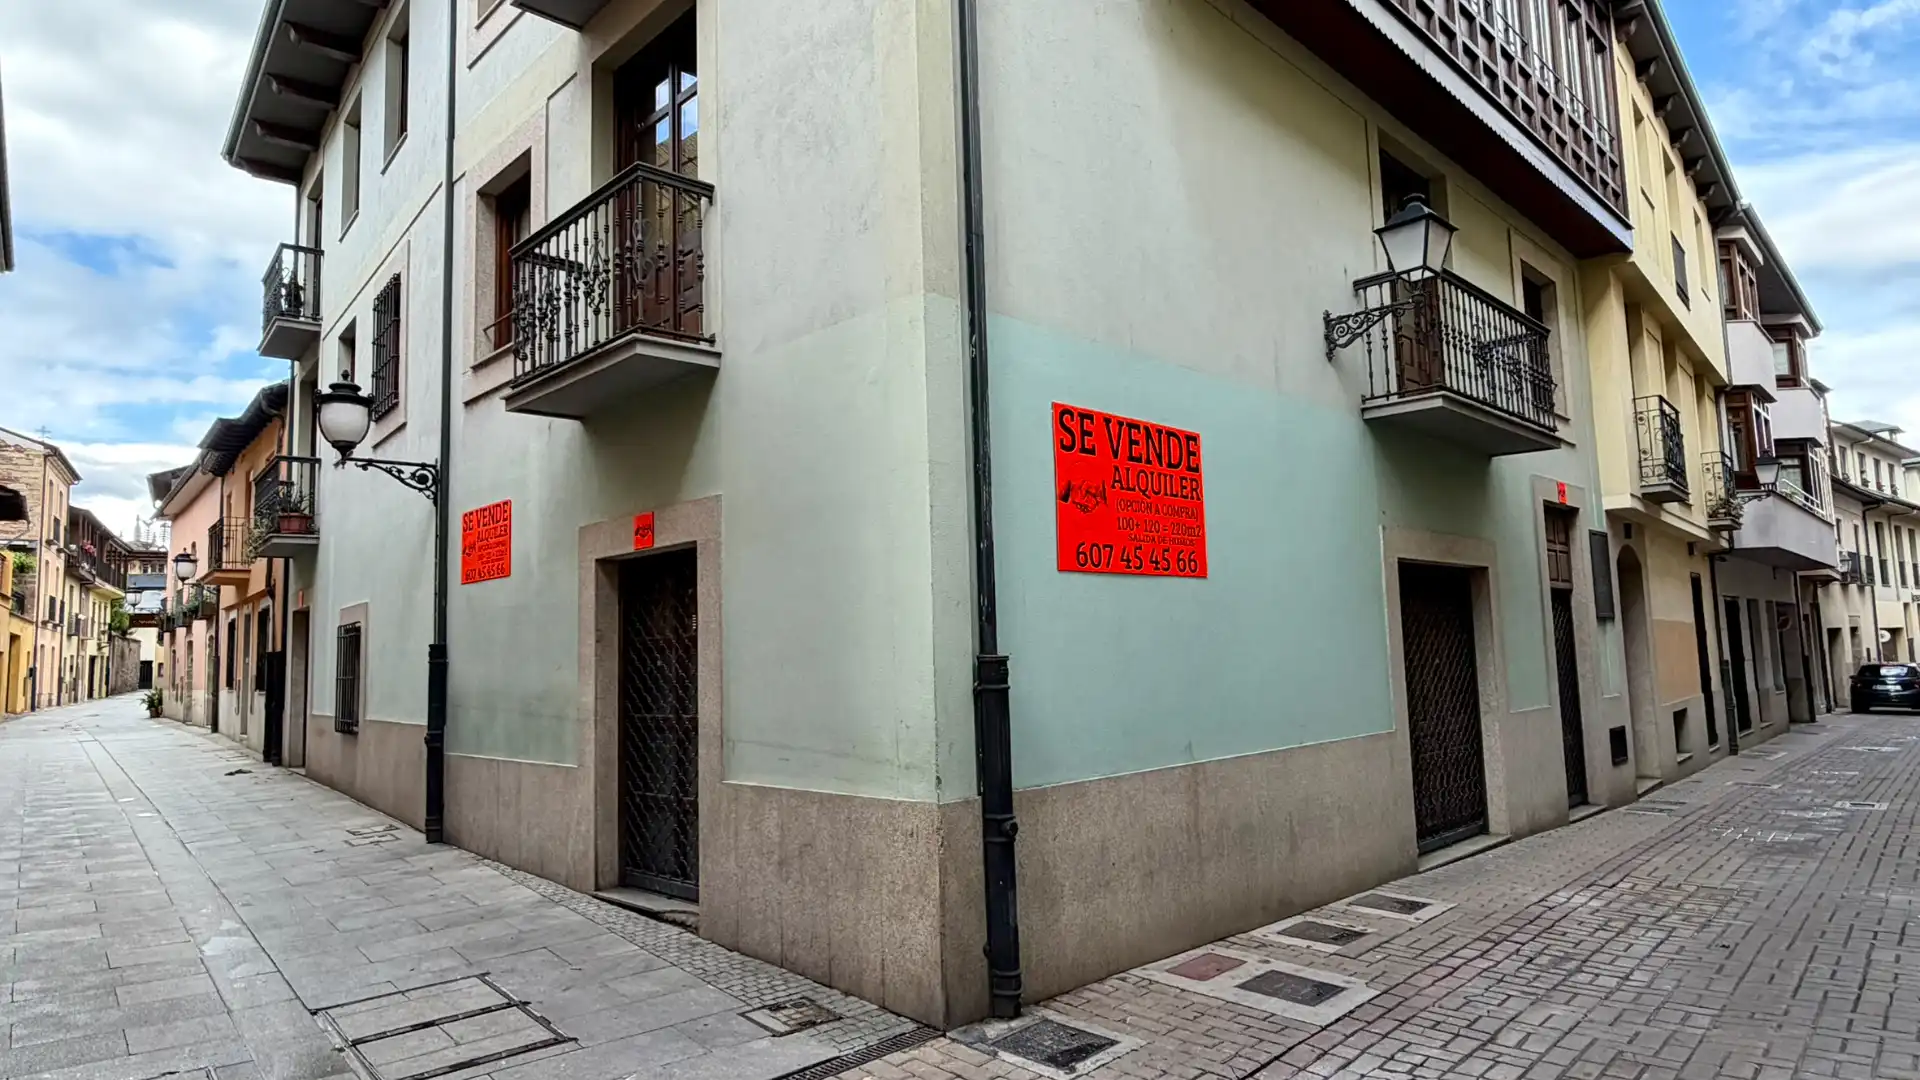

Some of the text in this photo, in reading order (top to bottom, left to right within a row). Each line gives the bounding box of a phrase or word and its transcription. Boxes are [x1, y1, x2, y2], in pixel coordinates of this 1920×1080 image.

[1058, 408, 1200, 473] SE VENDE
[1111, 465, 1202, 501] ALQUILER
[462, 501, 509, 532] SE VENDE
[1155, 503, 1161, 515] A
[1143, 518, 1161, 533] 120
[1158, 535, 1169, 545] DE
[1075, 541, 1199, 574] 607 45 45 66
